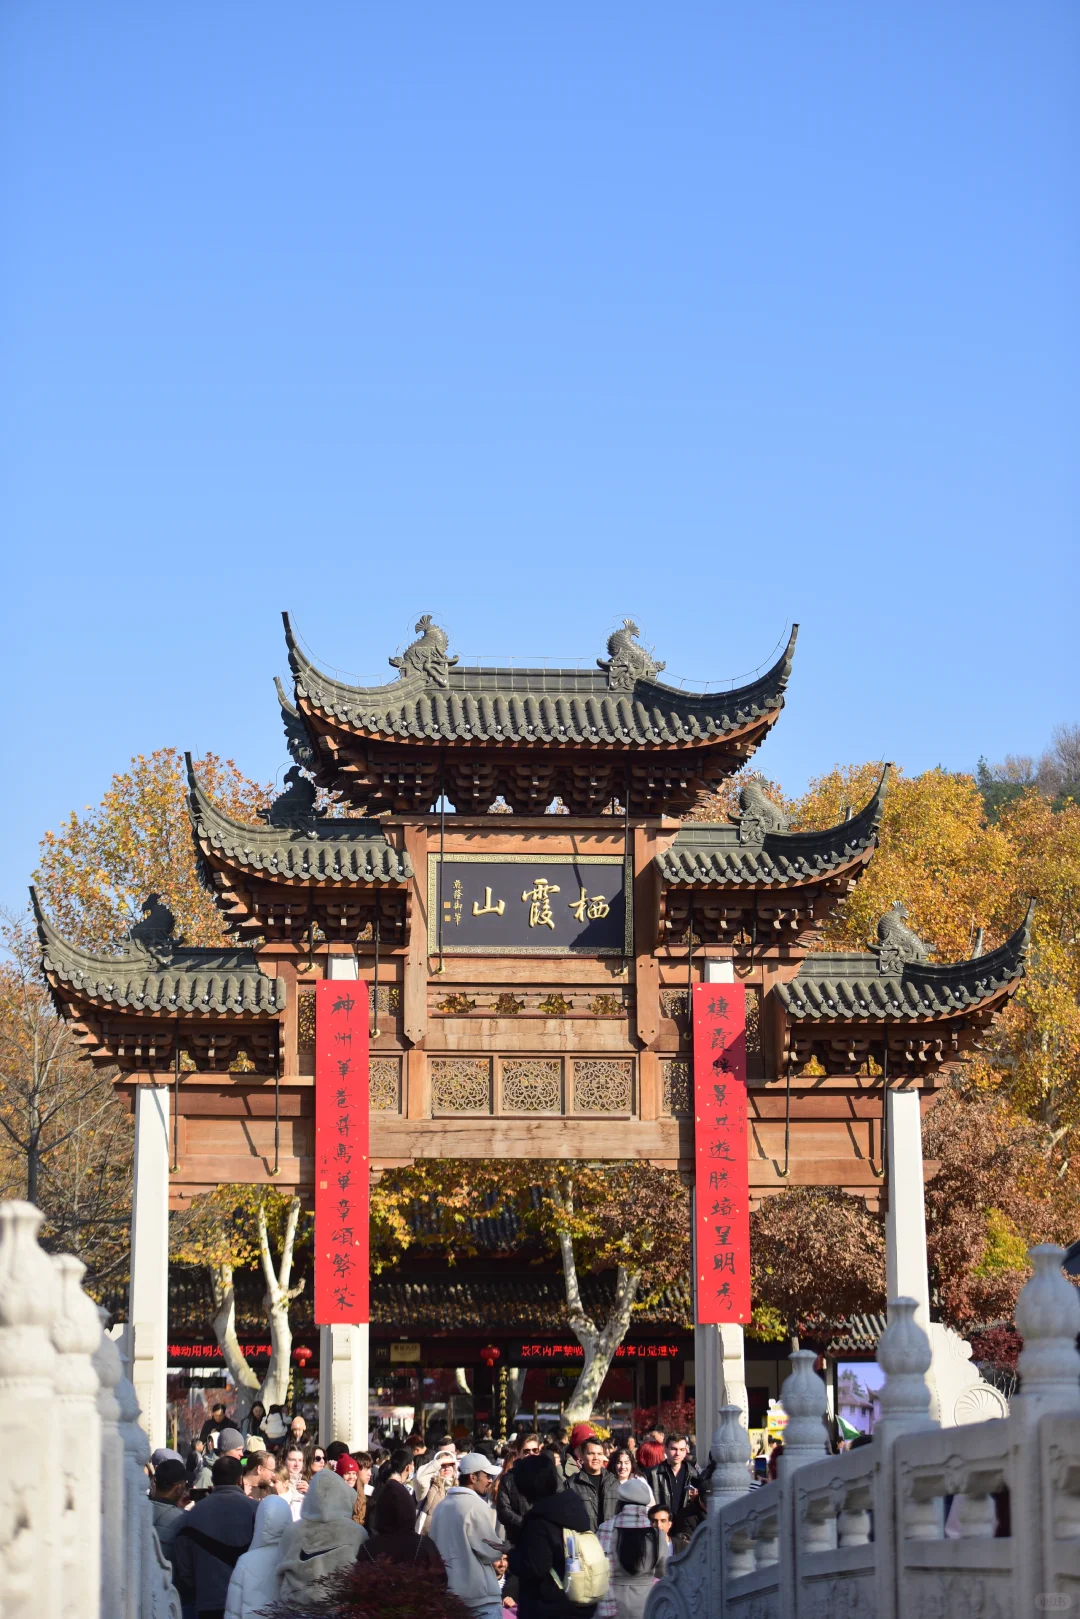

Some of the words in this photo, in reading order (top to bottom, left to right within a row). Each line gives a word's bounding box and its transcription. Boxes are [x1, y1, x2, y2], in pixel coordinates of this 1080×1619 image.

[167, 1344, 224, 1357] 禁动用明火
